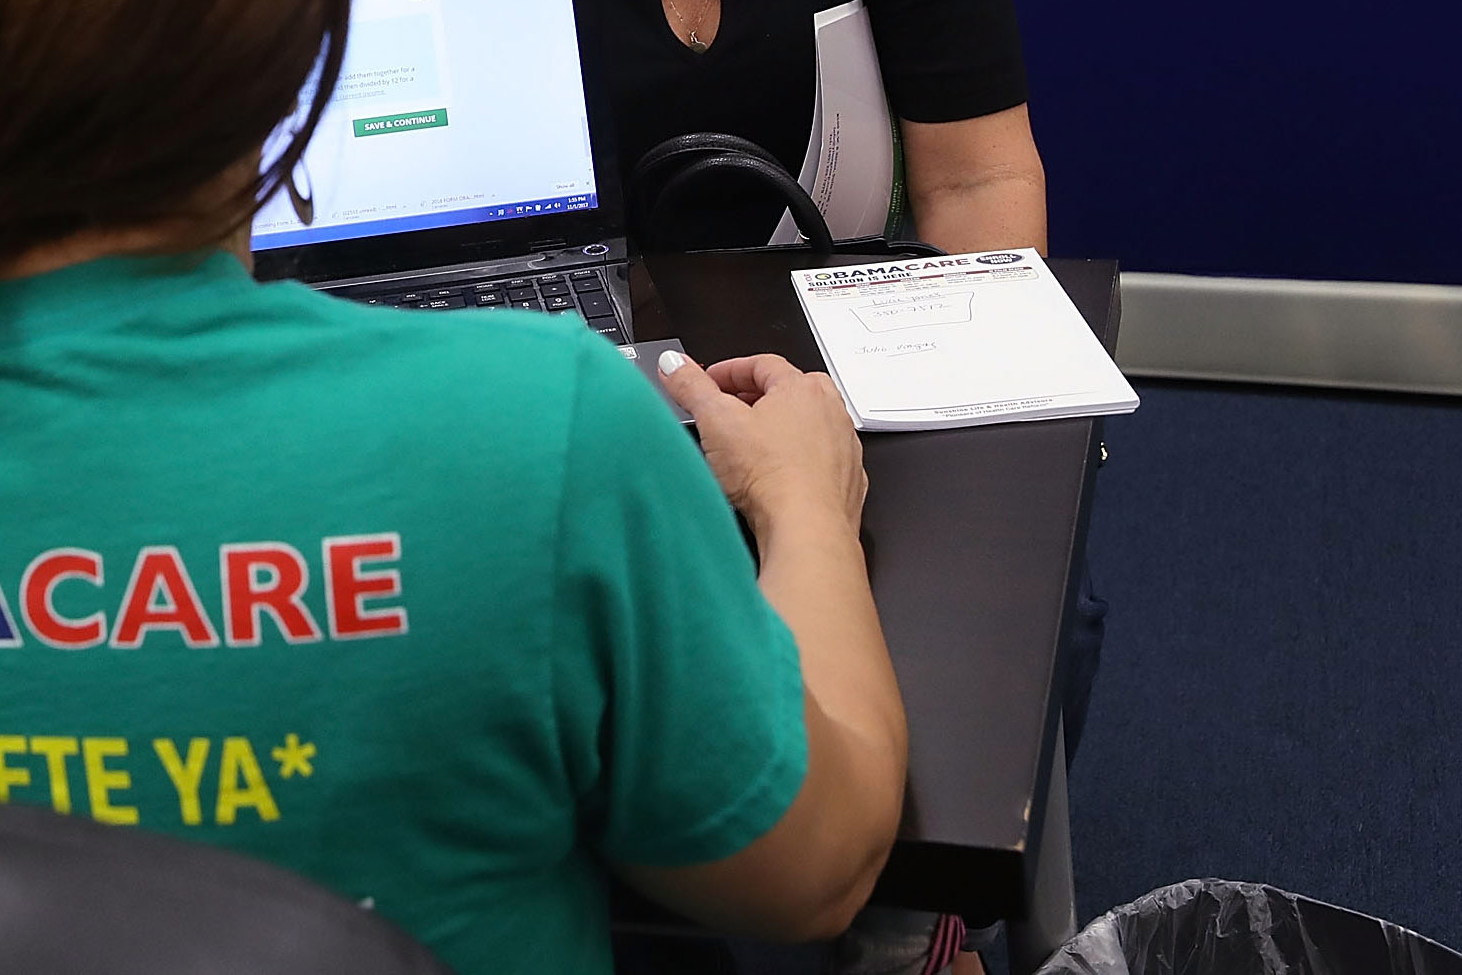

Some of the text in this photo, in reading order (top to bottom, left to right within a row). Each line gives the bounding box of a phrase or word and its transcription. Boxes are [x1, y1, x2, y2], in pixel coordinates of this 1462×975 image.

[364, 115, 436, 131] SAVE & CONTINUE
[979, 253, 1017, 262] ENROLL
[815, 258, 970, 280] OBAMACARE
[808, 277, 864, 287] SOLUTION
[883, 272, 913, 280] HERE
